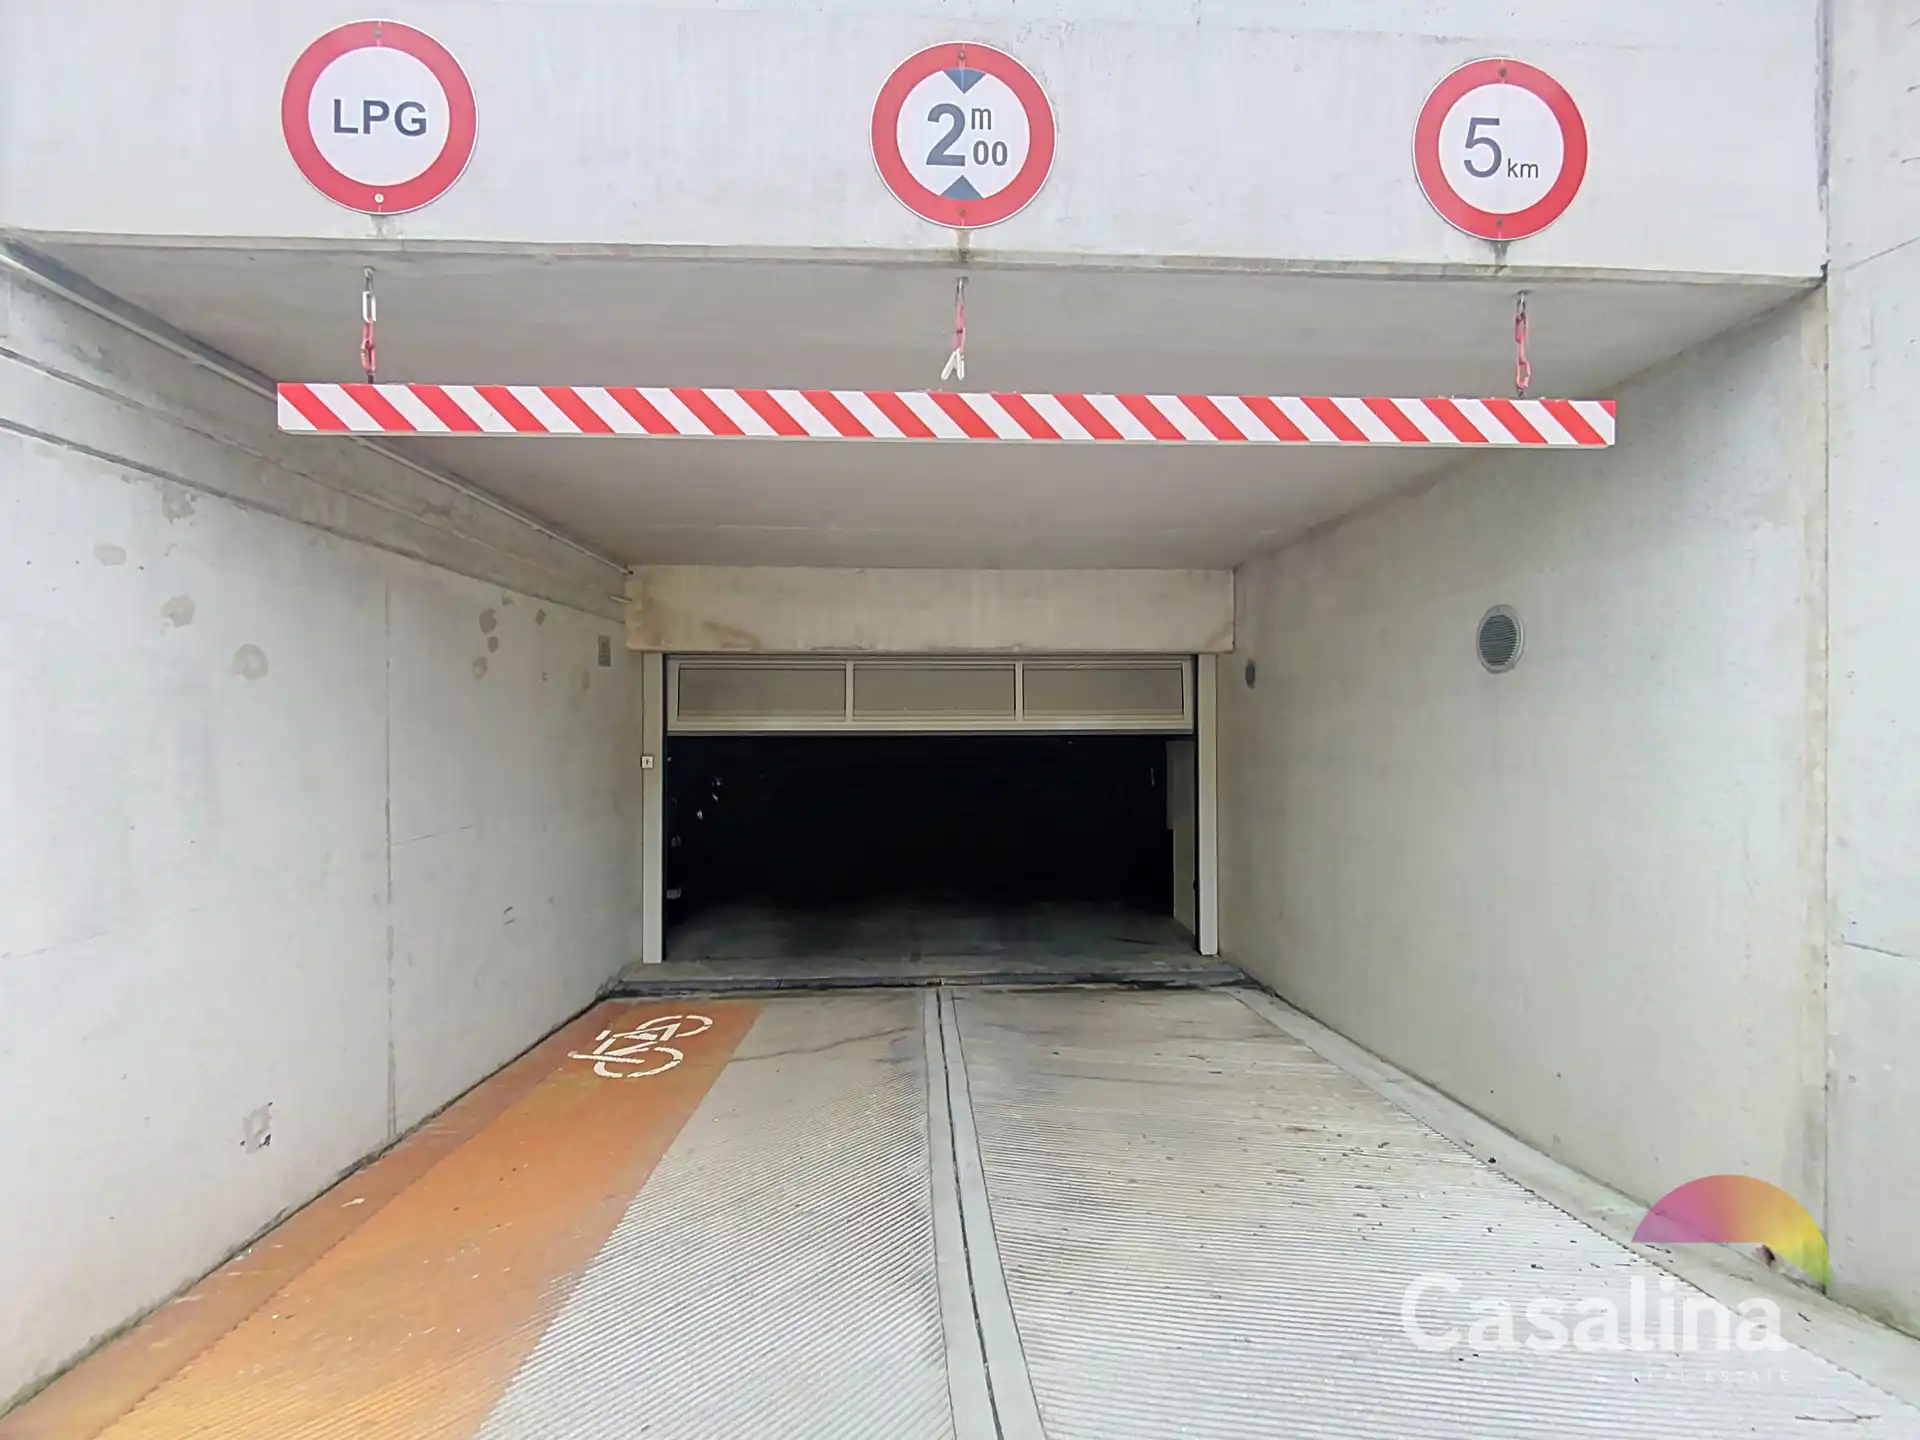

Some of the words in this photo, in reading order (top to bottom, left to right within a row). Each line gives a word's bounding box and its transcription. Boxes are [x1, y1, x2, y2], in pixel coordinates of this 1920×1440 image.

[333, 98, 428, 137] LPG
[925, 103, 966, 167] 2
[971, 107, 992, 130] m
[972, 140, 1008, 167] 00
[1463, 117, 1502, 178] 5
[1507, 157, 1539, 179] km
